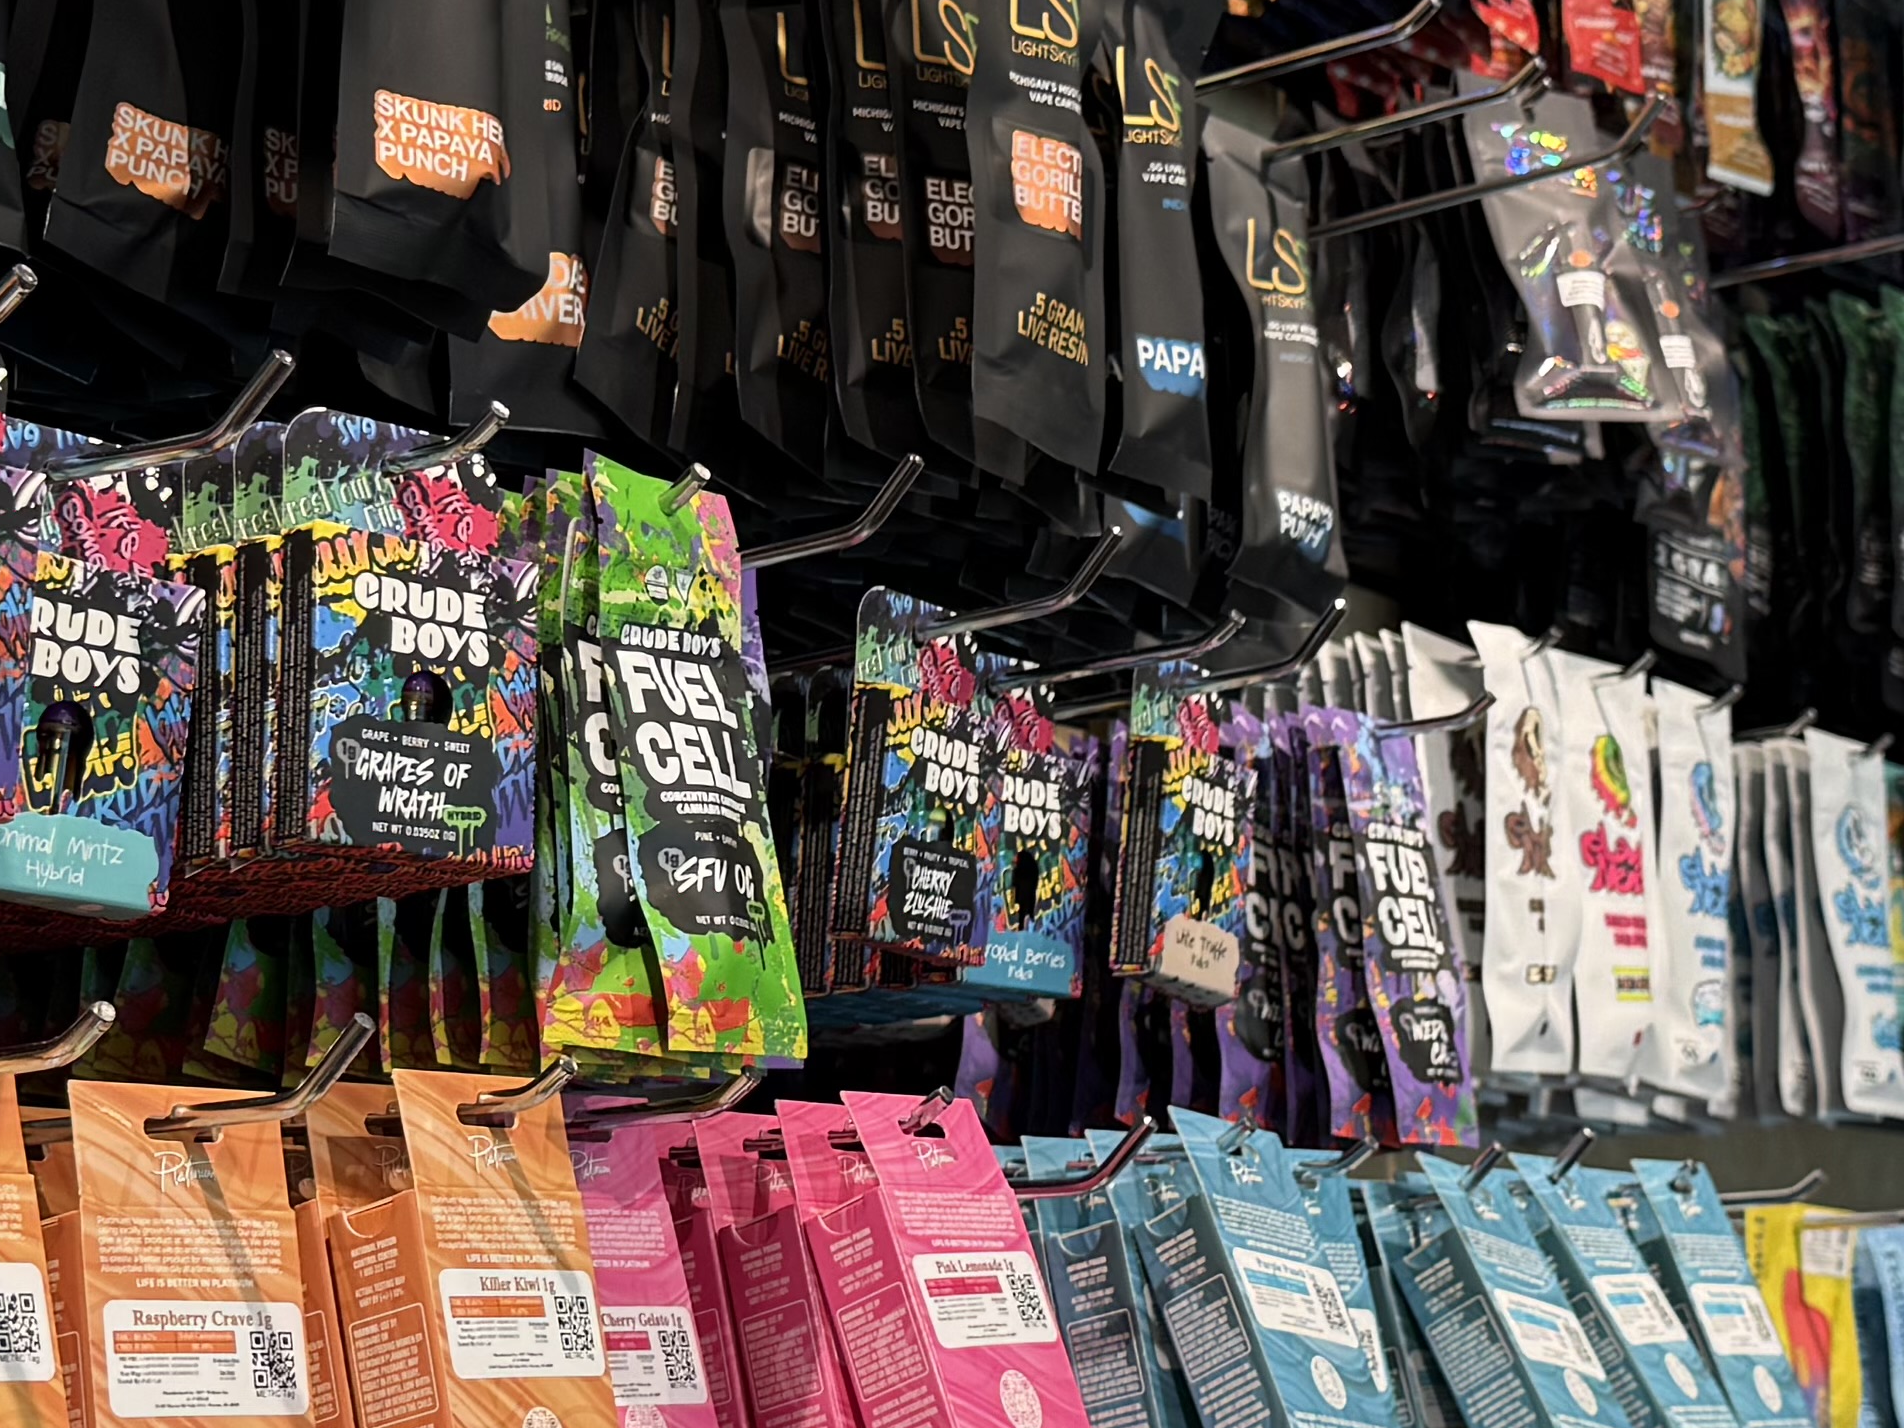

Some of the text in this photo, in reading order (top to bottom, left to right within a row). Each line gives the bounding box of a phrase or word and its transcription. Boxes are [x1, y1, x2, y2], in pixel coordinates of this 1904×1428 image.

[376, 93, 467, 132] SKUNK
[378, 116, 494, 165] X PAPAYA
[378, 141, 468, 182] PUNCH
[1031, 292, 1084, 335] .5 GRAM
[1018, 310, 1088, 367] LIVE RESIN
[353, 572, 487, 628] CRUDE
[390, 621, 490, 667] BOYS
[620, 623, 721, 658] CRUDE BOYS
[31, 638, 140, 694] BOYS
[616, 650, 739, 729] FUEL
[361, 726, 470, 754] GRAPE BERRY SWEET
[634, 718, 752, 799] CELL
[910, 725, 981, 772] CRUDE
[355, 745, 469, 788] GRAPES OF
[924, 763, 979, 805] BOYS
[378, 785, 445, 821] WRATH
[1004, 804, 1062, 840] BOYS
[67, 835, 124, 865] Mintz
[25, 858, 85, 888] Hybrid
[673, 856, 727, 894] SFV
[910, 864, 955, 893] CHERRY
[478, 1274, 556, 1297] Killer Kiwi 1g
[935, 1258, 1002, 1275] Pink Lemonade
[131, 1308, 273, 1333] Raspberry Crave 1g
[601, 1312, 667, 1333] Cherry Gelato
